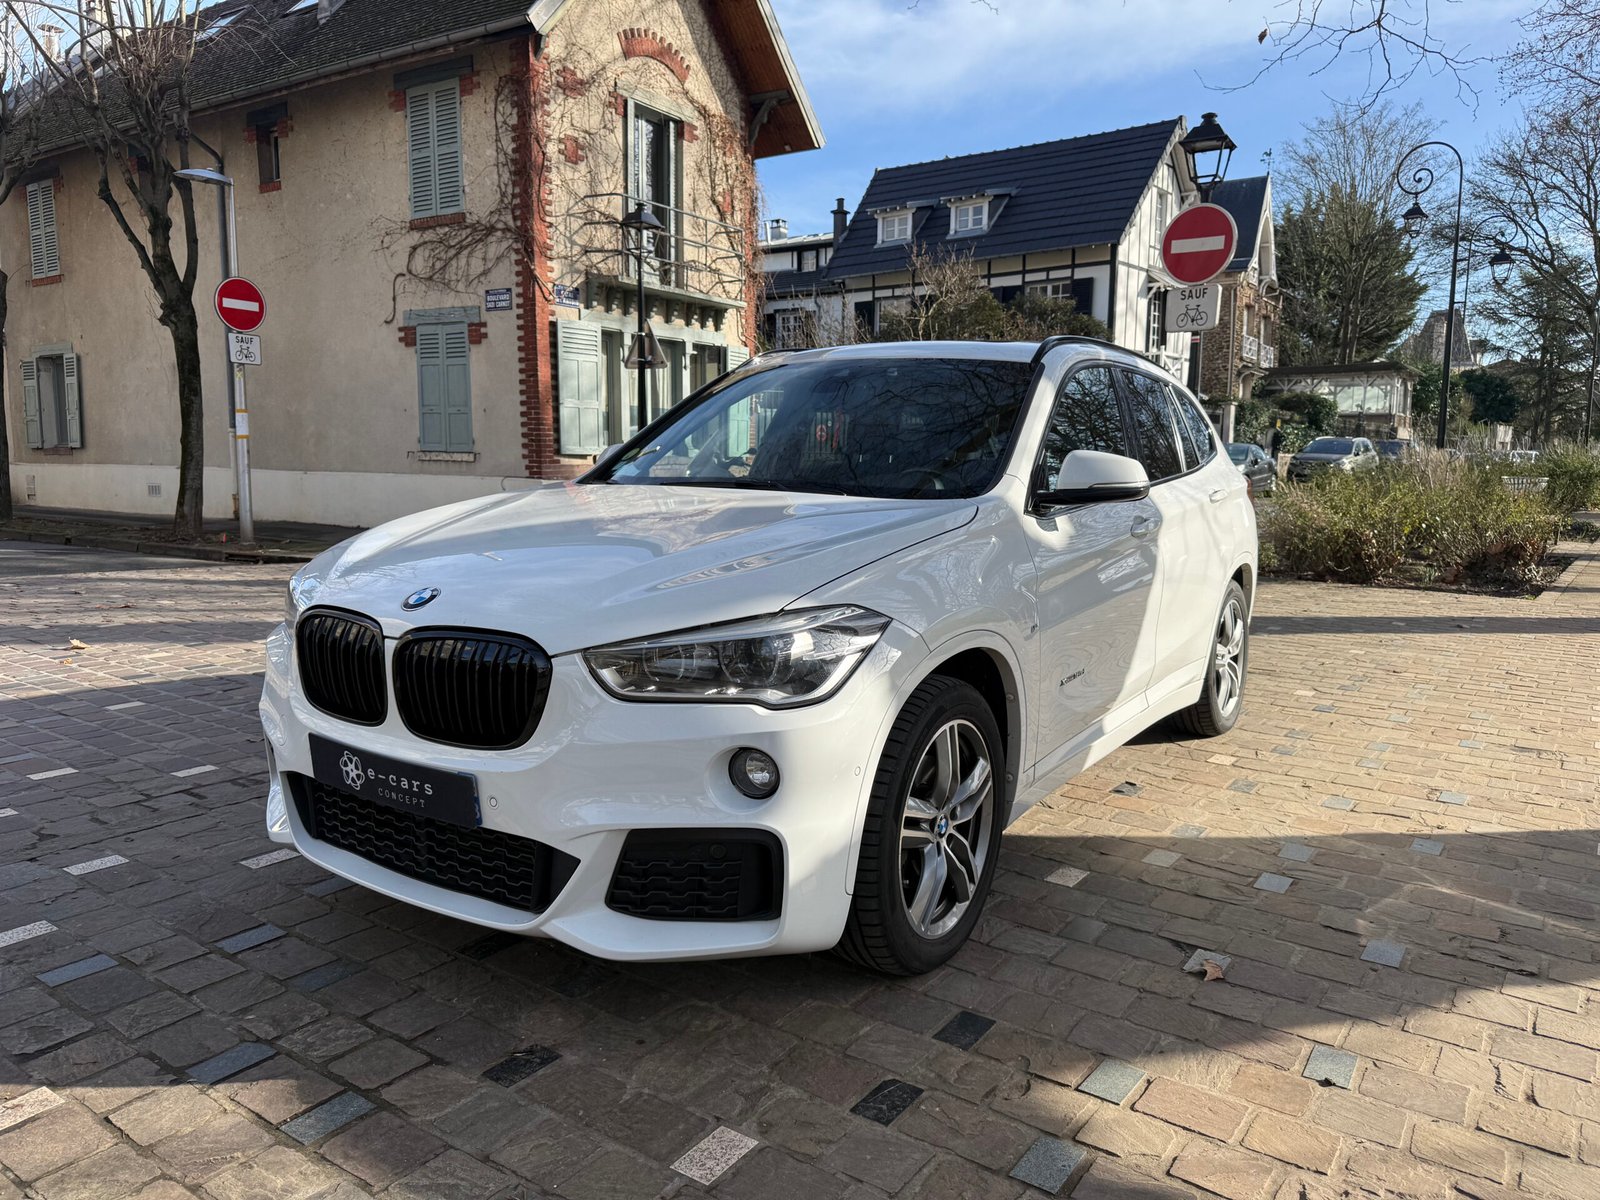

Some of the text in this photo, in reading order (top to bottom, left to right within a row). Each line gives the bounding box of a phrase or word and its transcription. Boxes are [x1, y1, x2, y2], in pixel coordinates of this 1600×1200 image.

[1180, 288, 1208, 300] SAUF
[235, 336, 254, 345] SAUF
[367, 768, 433, 795] e-cars
[378, 787, 425, 808] CONCEPT
